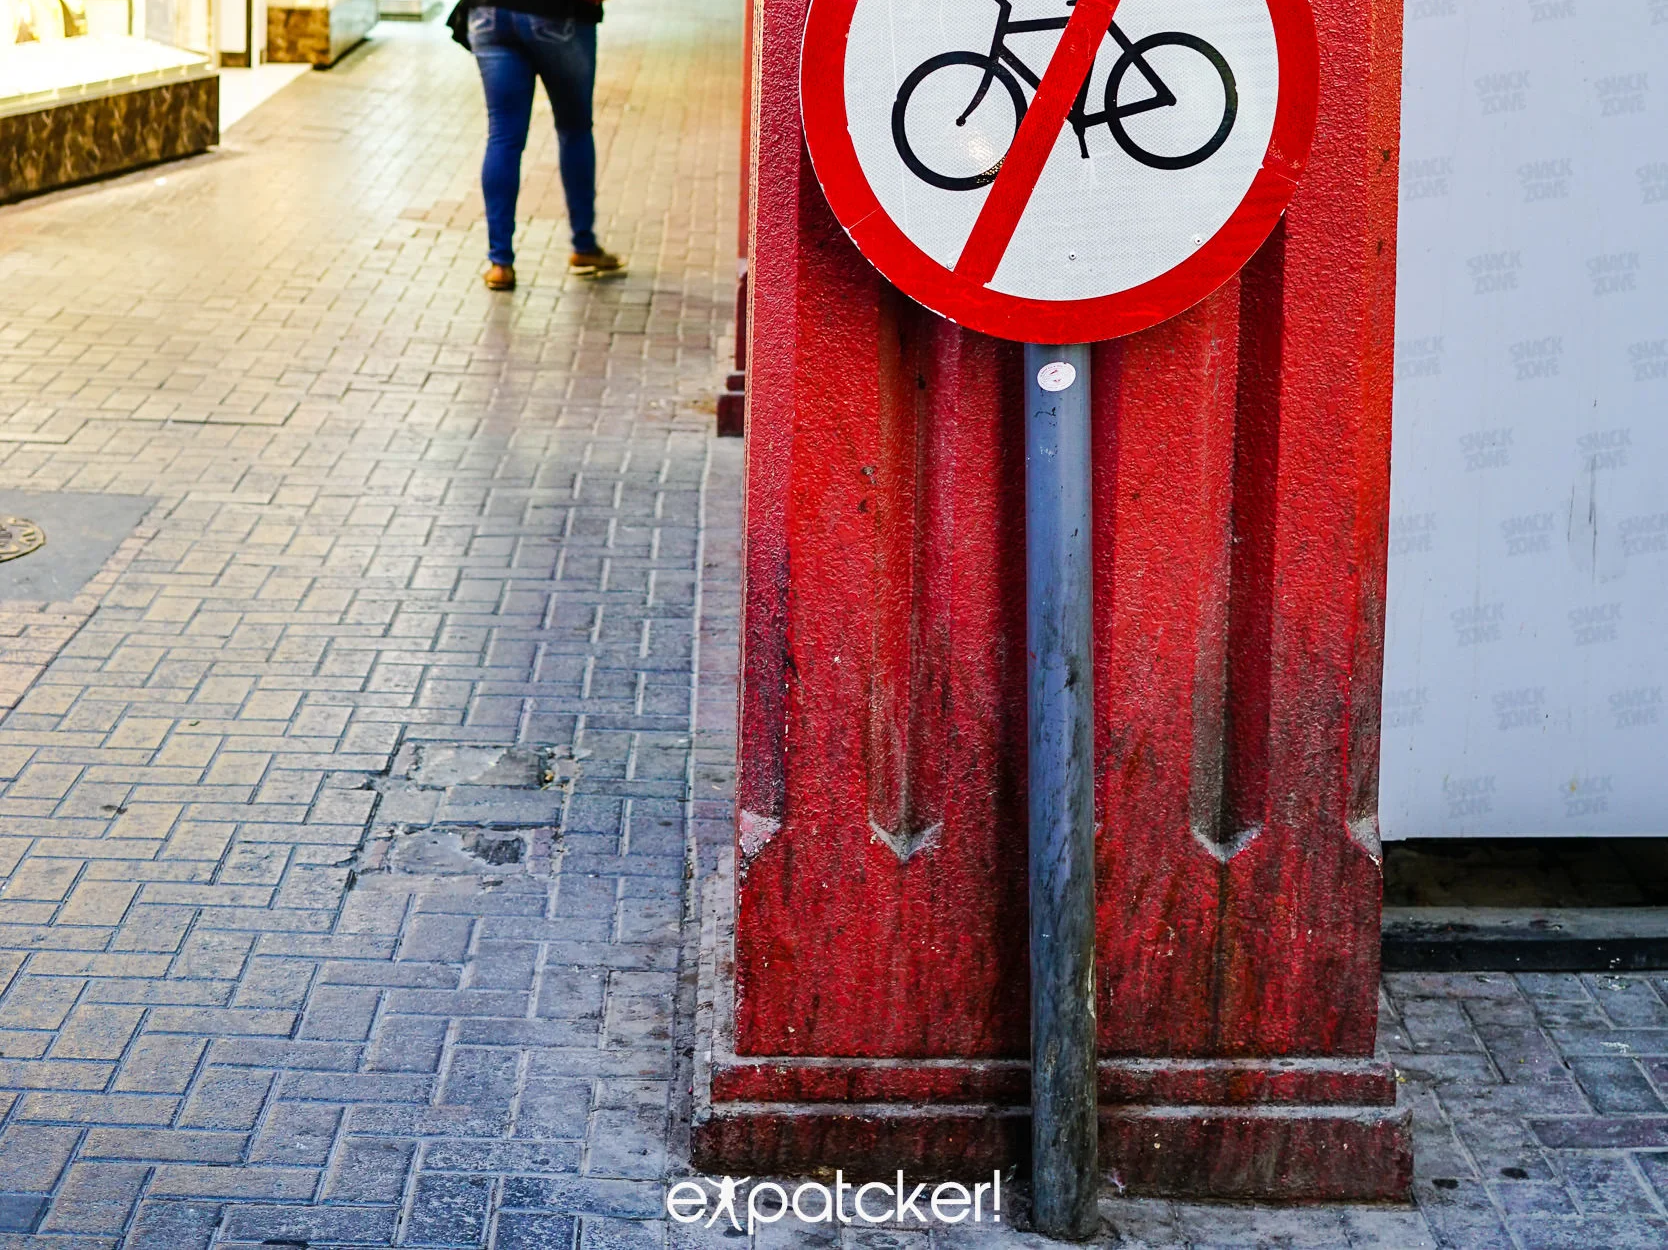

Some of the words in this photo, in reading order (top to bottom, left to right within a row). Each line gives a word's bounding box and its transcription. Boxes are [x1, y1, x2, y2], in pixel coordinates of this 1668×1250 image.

[1531, 0, 1577, 24] ZONE
[1474, 71, 1531, 98] SNACK
[1594, 73, 1650, 100] SNACK
[1480, 92, 1526, 116] ZONE
[1600, 94, 1646, 117] ZONE
[1517, 159, 1573, 185] SNACK
[1635, 162, 1668, 187] SNA
[1404, 178, 1449, 201] ZONE
[1523, 179, 1569, 203] ZONE
[1642, 182, 1668, 204] ZO
[1466, 251, 1522, 276] SNACK
[1586, 253, 1641, 278] SNACK
[1473, 272, 1518, 295] ZONE
[1592, 273, 1637, 296] ZONE
[1508, 336, 1564, 362] SNACK
[1627, 339, 1668, 364] SNAC
[1397, 357, 1441, 380] ZONE
[1515, 357, 1560, 381] ZONE
[1633, 359, 1668, 382] ZON
[1459, 428, 1514, 454] SNACK
[1576, 428, 1632, 454] SNACK
[1465, 450, 1510, 473] ZONE
[1583, 450, 1628, 473] ZONE
[1499, 512, 1555, 538] SNACK
[1391, 533, 1433, 556] ZONE
[1506, 534, 1551, 557] ZONE
[1624, 534, 1668, 558] ZONE
[1450, 603, 1504, 629] SNACK
[1567, 602, 1622, 629] SNACK
[1456, 623, 1501, 647] ZONE
[1574, 623, 1618, 646] ZONE
[1382, 687, 1429, 710] NACK
[1491, 687, 1545, 713] SNACK
[1608, 686, 1662, 712] SNACK
[1497, 707, 1542, 731] ZONE
[1614, 706, 1658, 730] ZONE
[1442, 775, 1496, 801] SNACK
[1558, 775, 1613, 801] SNACK
[1448, 796, 1493, 819] ZONE
[1565, 795, 1609, 818] ZONE
